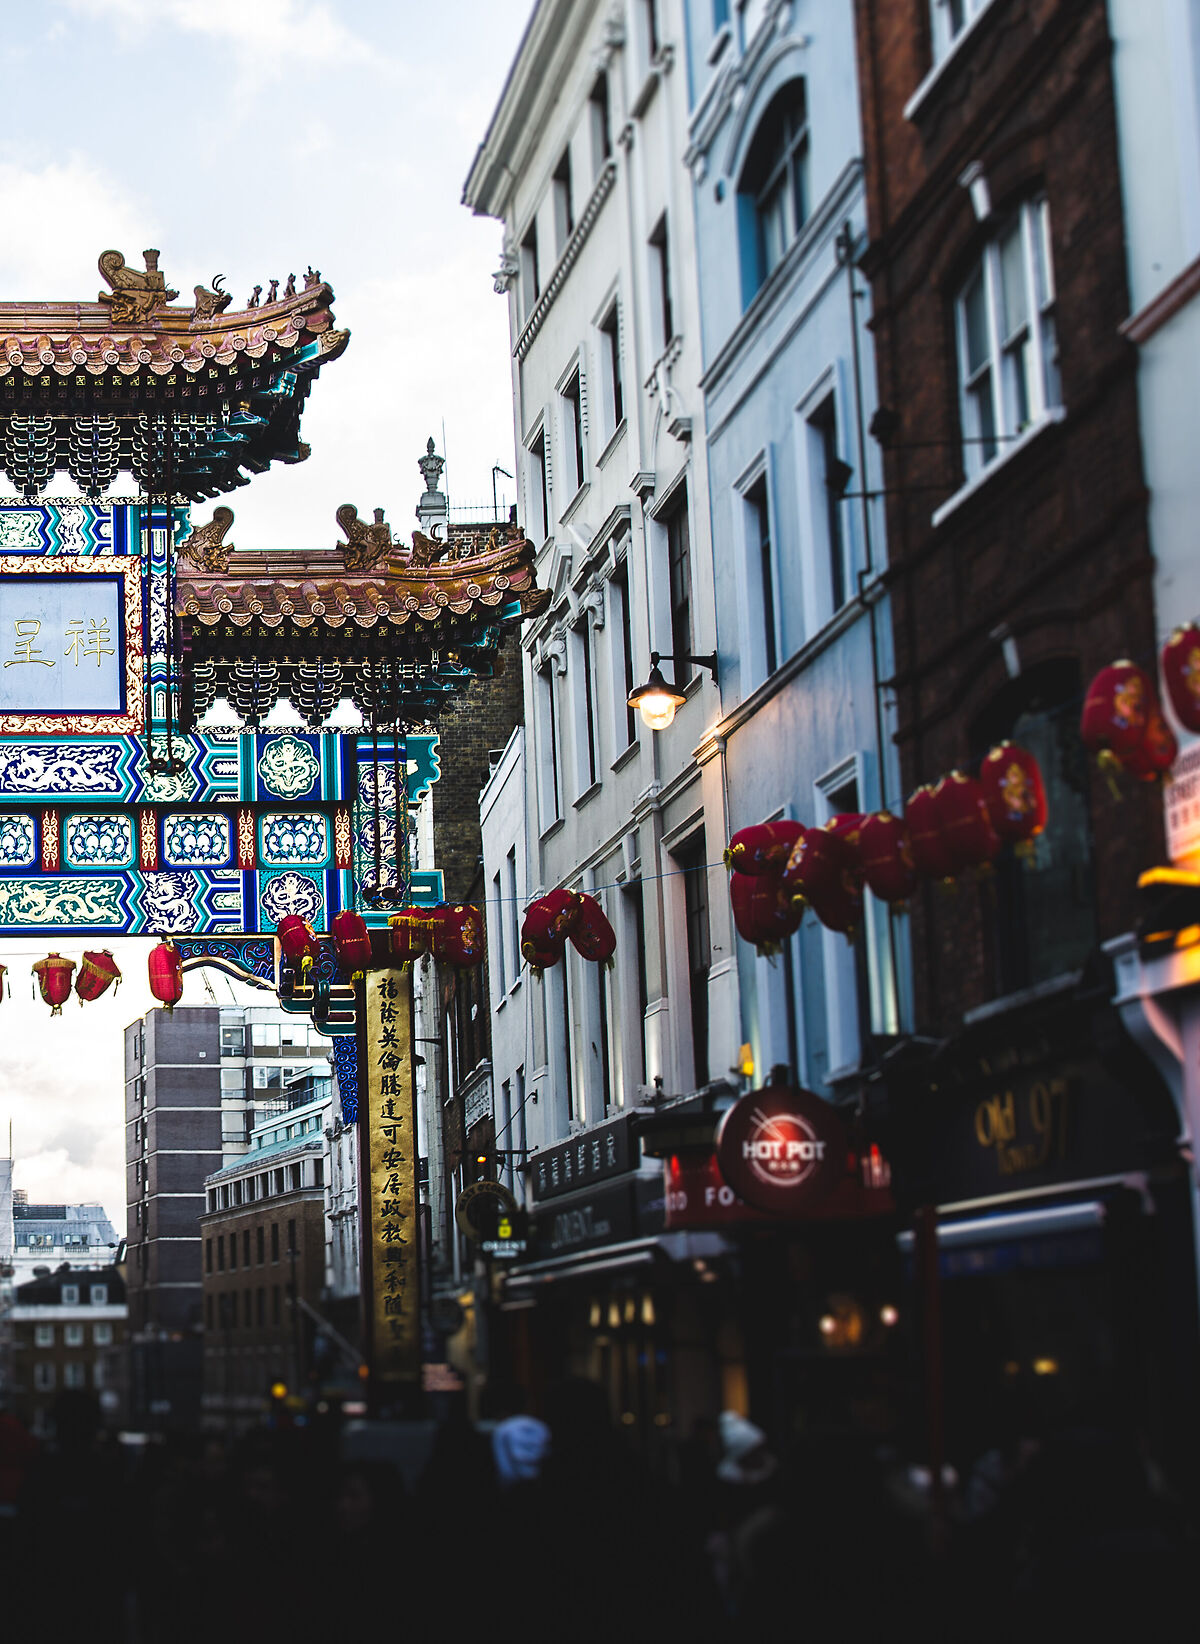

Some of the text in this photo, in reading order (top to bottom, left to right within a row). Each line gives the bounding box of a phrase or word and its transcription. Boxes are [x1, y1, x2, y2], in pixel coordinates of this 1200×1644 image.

[742, 1140, 826, 1161] HOT POT
[704, 1184, 744, 1207] FO
